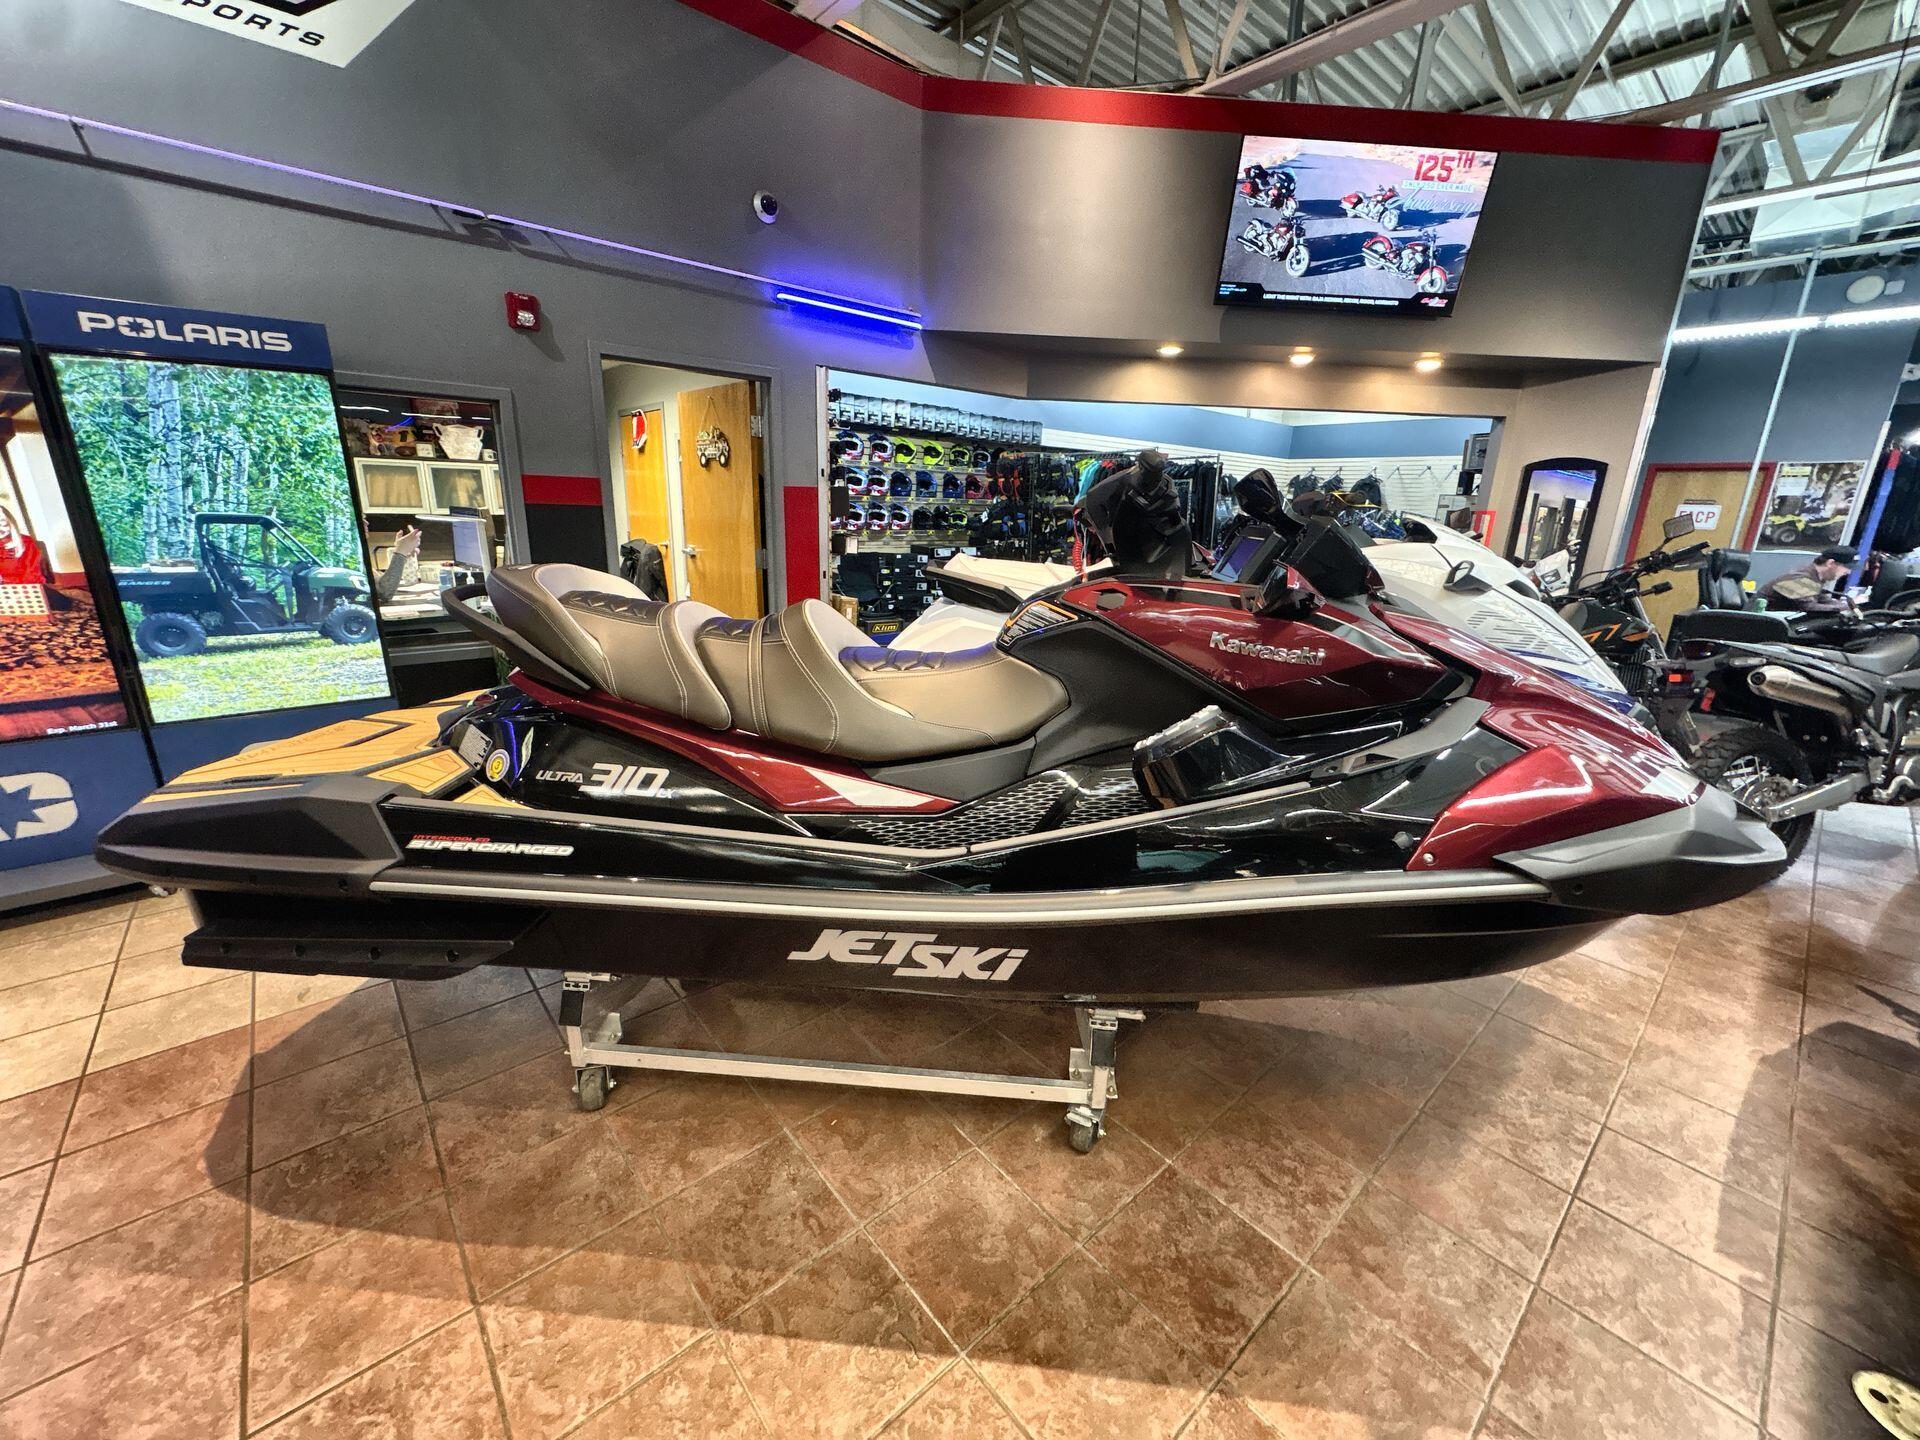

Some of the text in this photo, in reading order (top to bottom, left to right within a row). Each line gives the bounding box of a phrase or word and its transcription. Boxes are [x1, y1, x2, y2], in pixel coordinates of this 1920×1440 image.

[167, 0, 325, 46] PORTS
[76, 310, 293, 352] POLARIS
[873, 623, 898, 632] Klim
[1209, 631, 1327, 666] Kawasaki
[68, 723, 97, 732] March
[536, 769, 583, 783] ULTRA
[412, 834, 491, 843] INTERCOOLED
[405, 839, 575, 857] SUPERCHARGED
